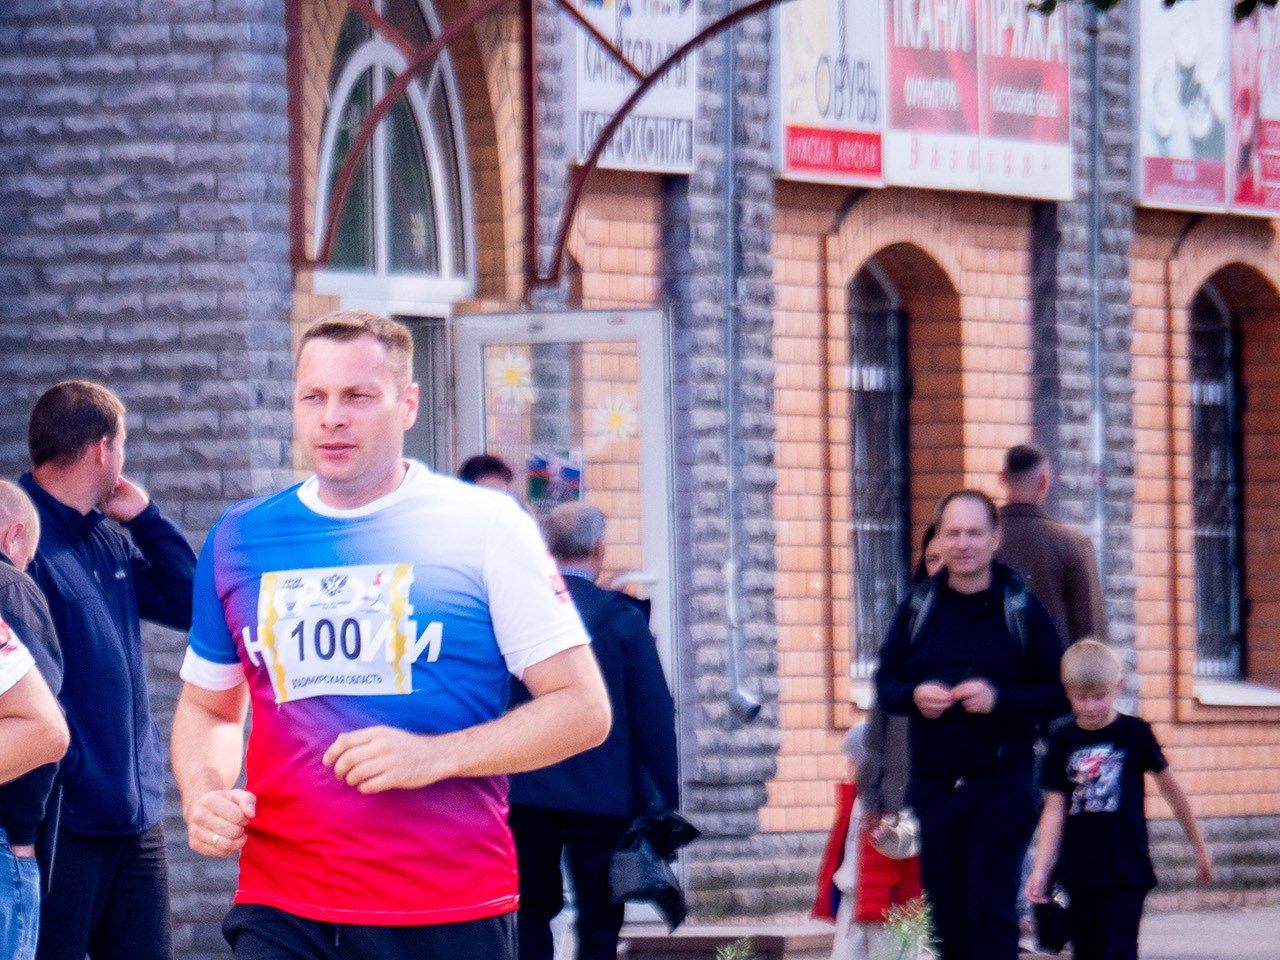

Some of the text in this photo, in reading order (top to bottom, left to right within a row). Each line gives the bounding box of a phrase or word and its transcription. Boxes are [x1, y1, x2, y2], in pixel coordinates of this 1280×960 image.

[893, 0, 970, 52] ТКАНИ
[815, 55, 878, 122] ОБУВЬ
[290, 618, 361, 661] 100
